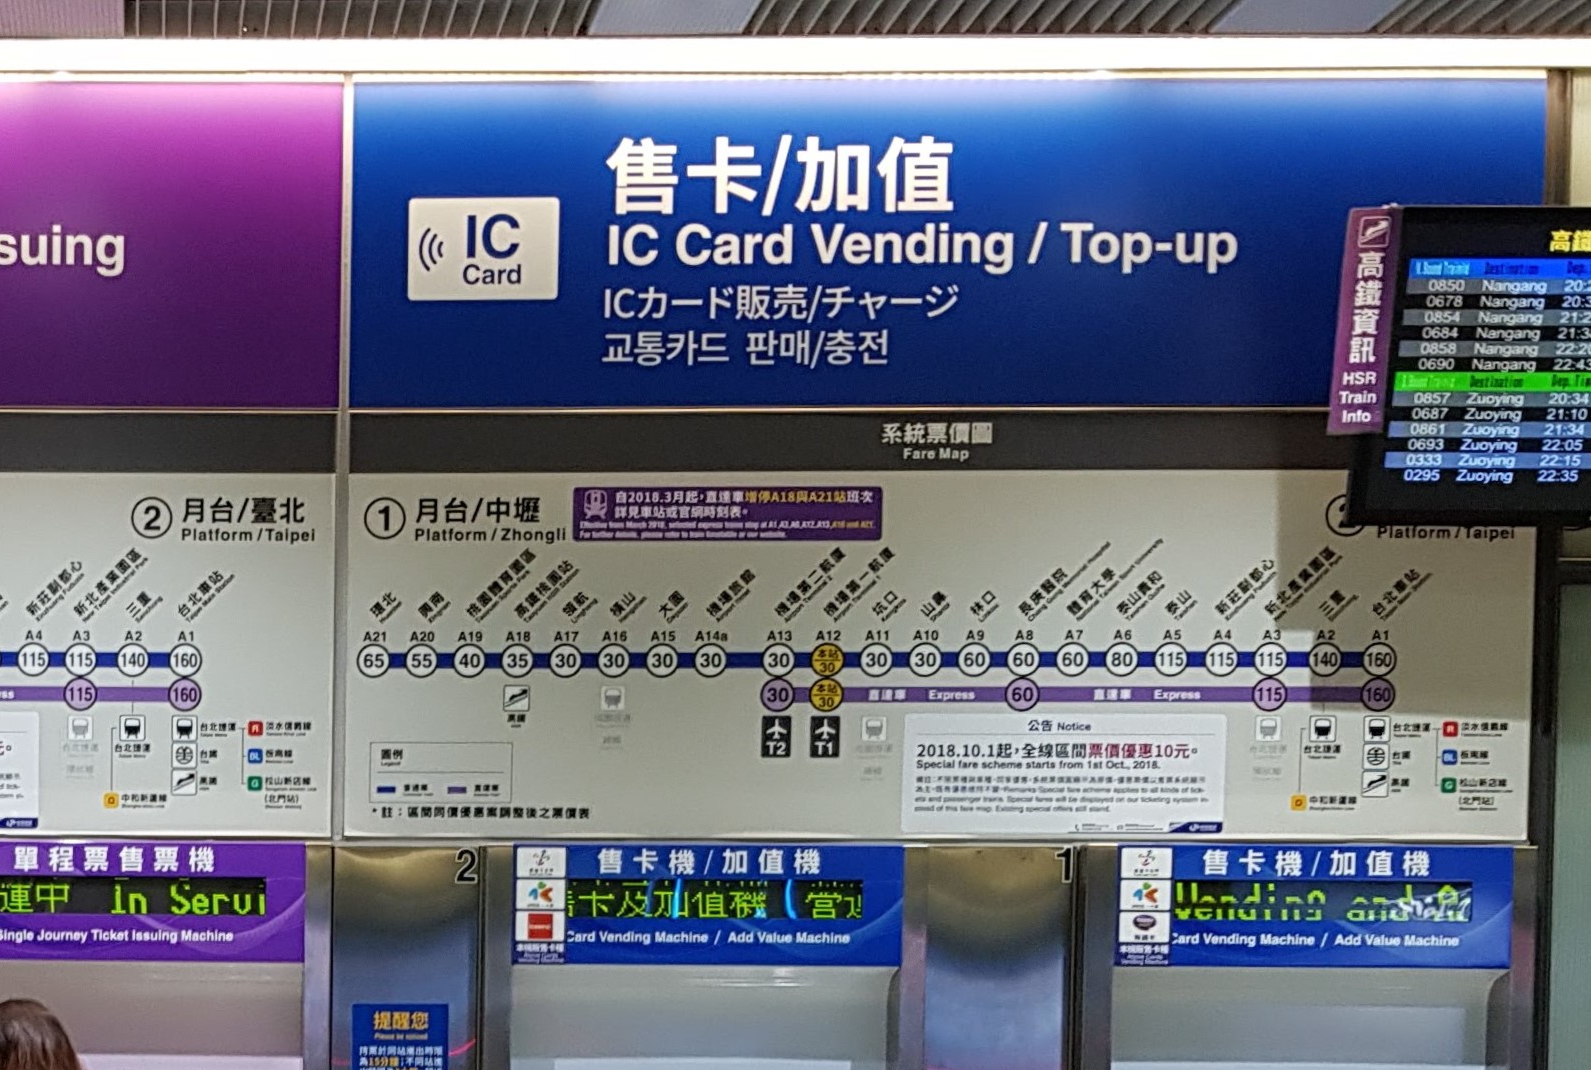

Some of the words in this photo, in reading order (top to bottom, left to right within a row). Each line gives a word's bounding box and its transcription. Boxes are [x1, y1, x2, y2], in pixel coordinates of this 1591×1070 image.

[606, 135, 953, 215] 售卡/加值
[467, 214, 519, 259] IC
[609, 224, 658, 265] IC
[676, 223, 793, 265] Card
[811, 223, 1013, 274] Vending
[1060, 223, 1237, 273] Top-up
[463, 264, 521, 285] Card
[1429, 280, 1465, 291] 0850
[1482, 280, 1547, 294] Nangang
[605, 284, 958, 323] ICカード販売/チャージ
[1349, 251, 1384, 363] 高鐵資訊
[1426, 296, 1463, 307] 0678
[1480, 296, 1545, 310] Nangang
[1422, 327, 1458, 339] 0684
[1476, 327, 1541, 341] Nangang
[602, 331, 729, 366] 교통카드
[746, 329, 887, 369] 판매/충전
[1418, 358, 1454, 370] 0690
[1472, 359, 1536, 372] Nangang
[1343, 372, 1376, 385] HSR
[1339, 391, 1376, 404] Train
[1413, 393, 1450, 403] 0857
[1466, 392, 1524, 407] Zuoying
[1549, 393, 1589, 404] 20:34
[1342, 410, 1371, 422] Info
[1412, 408, 1448, 419] 0687
[1465, 408, 1522, 422] Zuoying
[1546, 408, 1588, 420] 21:10
[882, 422, 992, 444] 系統票價圖
[1408, 439, 1444, 450] 0693
[1460, 439, 1517, 453] Zuoying
[1542, 439, 1583, 451] 22:05
[903, 448, 935, 459] Fare
[939, 448, 969, 462] Map
[1404, 469, 1439, 480] 0295
[1456, 469, 1513, 484] Zuoying
[1538, 470, 1578, 481] 22:35
[183, 497, 304, 524] 月台/臺北
[416, 497, 540, 523] 月台/中壢
[144, 506, 160, 530] 2
[182, 528, 252, 541] Platform
[265, 528, 315, 544] Taipei
[415, 528, 486, 541] Platform
[501, 528, 565, 544] Zhongli
[178, 631, 193, 644] A1
[364, 654, 384, 666] 65
[411, 654, 432, 666] 55
[459, 654, 480, 666] 40
[507, 654, 528, 666] 35
[928, 690, 975, 702] Express
[1058, 722, 1091, 731] Notice
[917, 760, 955, 770] Special
[958, 760, 978, 768] fare
[982, 761, 1022, 769] scheme
[1026, 761, 1055, 769] starts
[1059, 760, 1083, 769] from
[1088, 761, 1102, 769] 1st
[14, 846, 214, 872] 單程票售票機
[455, 847, 479, 885] 2
[598, 848, 820, 875] 售卡機/加值機
[1054, 846, 1073, 885] 1
[1203, 849, 1429, 877] 售卡機/加值機
[37, 929, 87, 943] Journey
[91, 929, 128, 941] Ticket
[132, 929, 178, 943] Issuing
[181, 930, 233, 941] Machine
[599, 931, 652, 946] Vending
[655, 931, 708, 943] Machine
[728, 930, 754, 943] Add
[757, 931, 792, 943] Value
[796, 932, 850, 943] Machine
[374, 1011, 428, 1030] 提醒您
